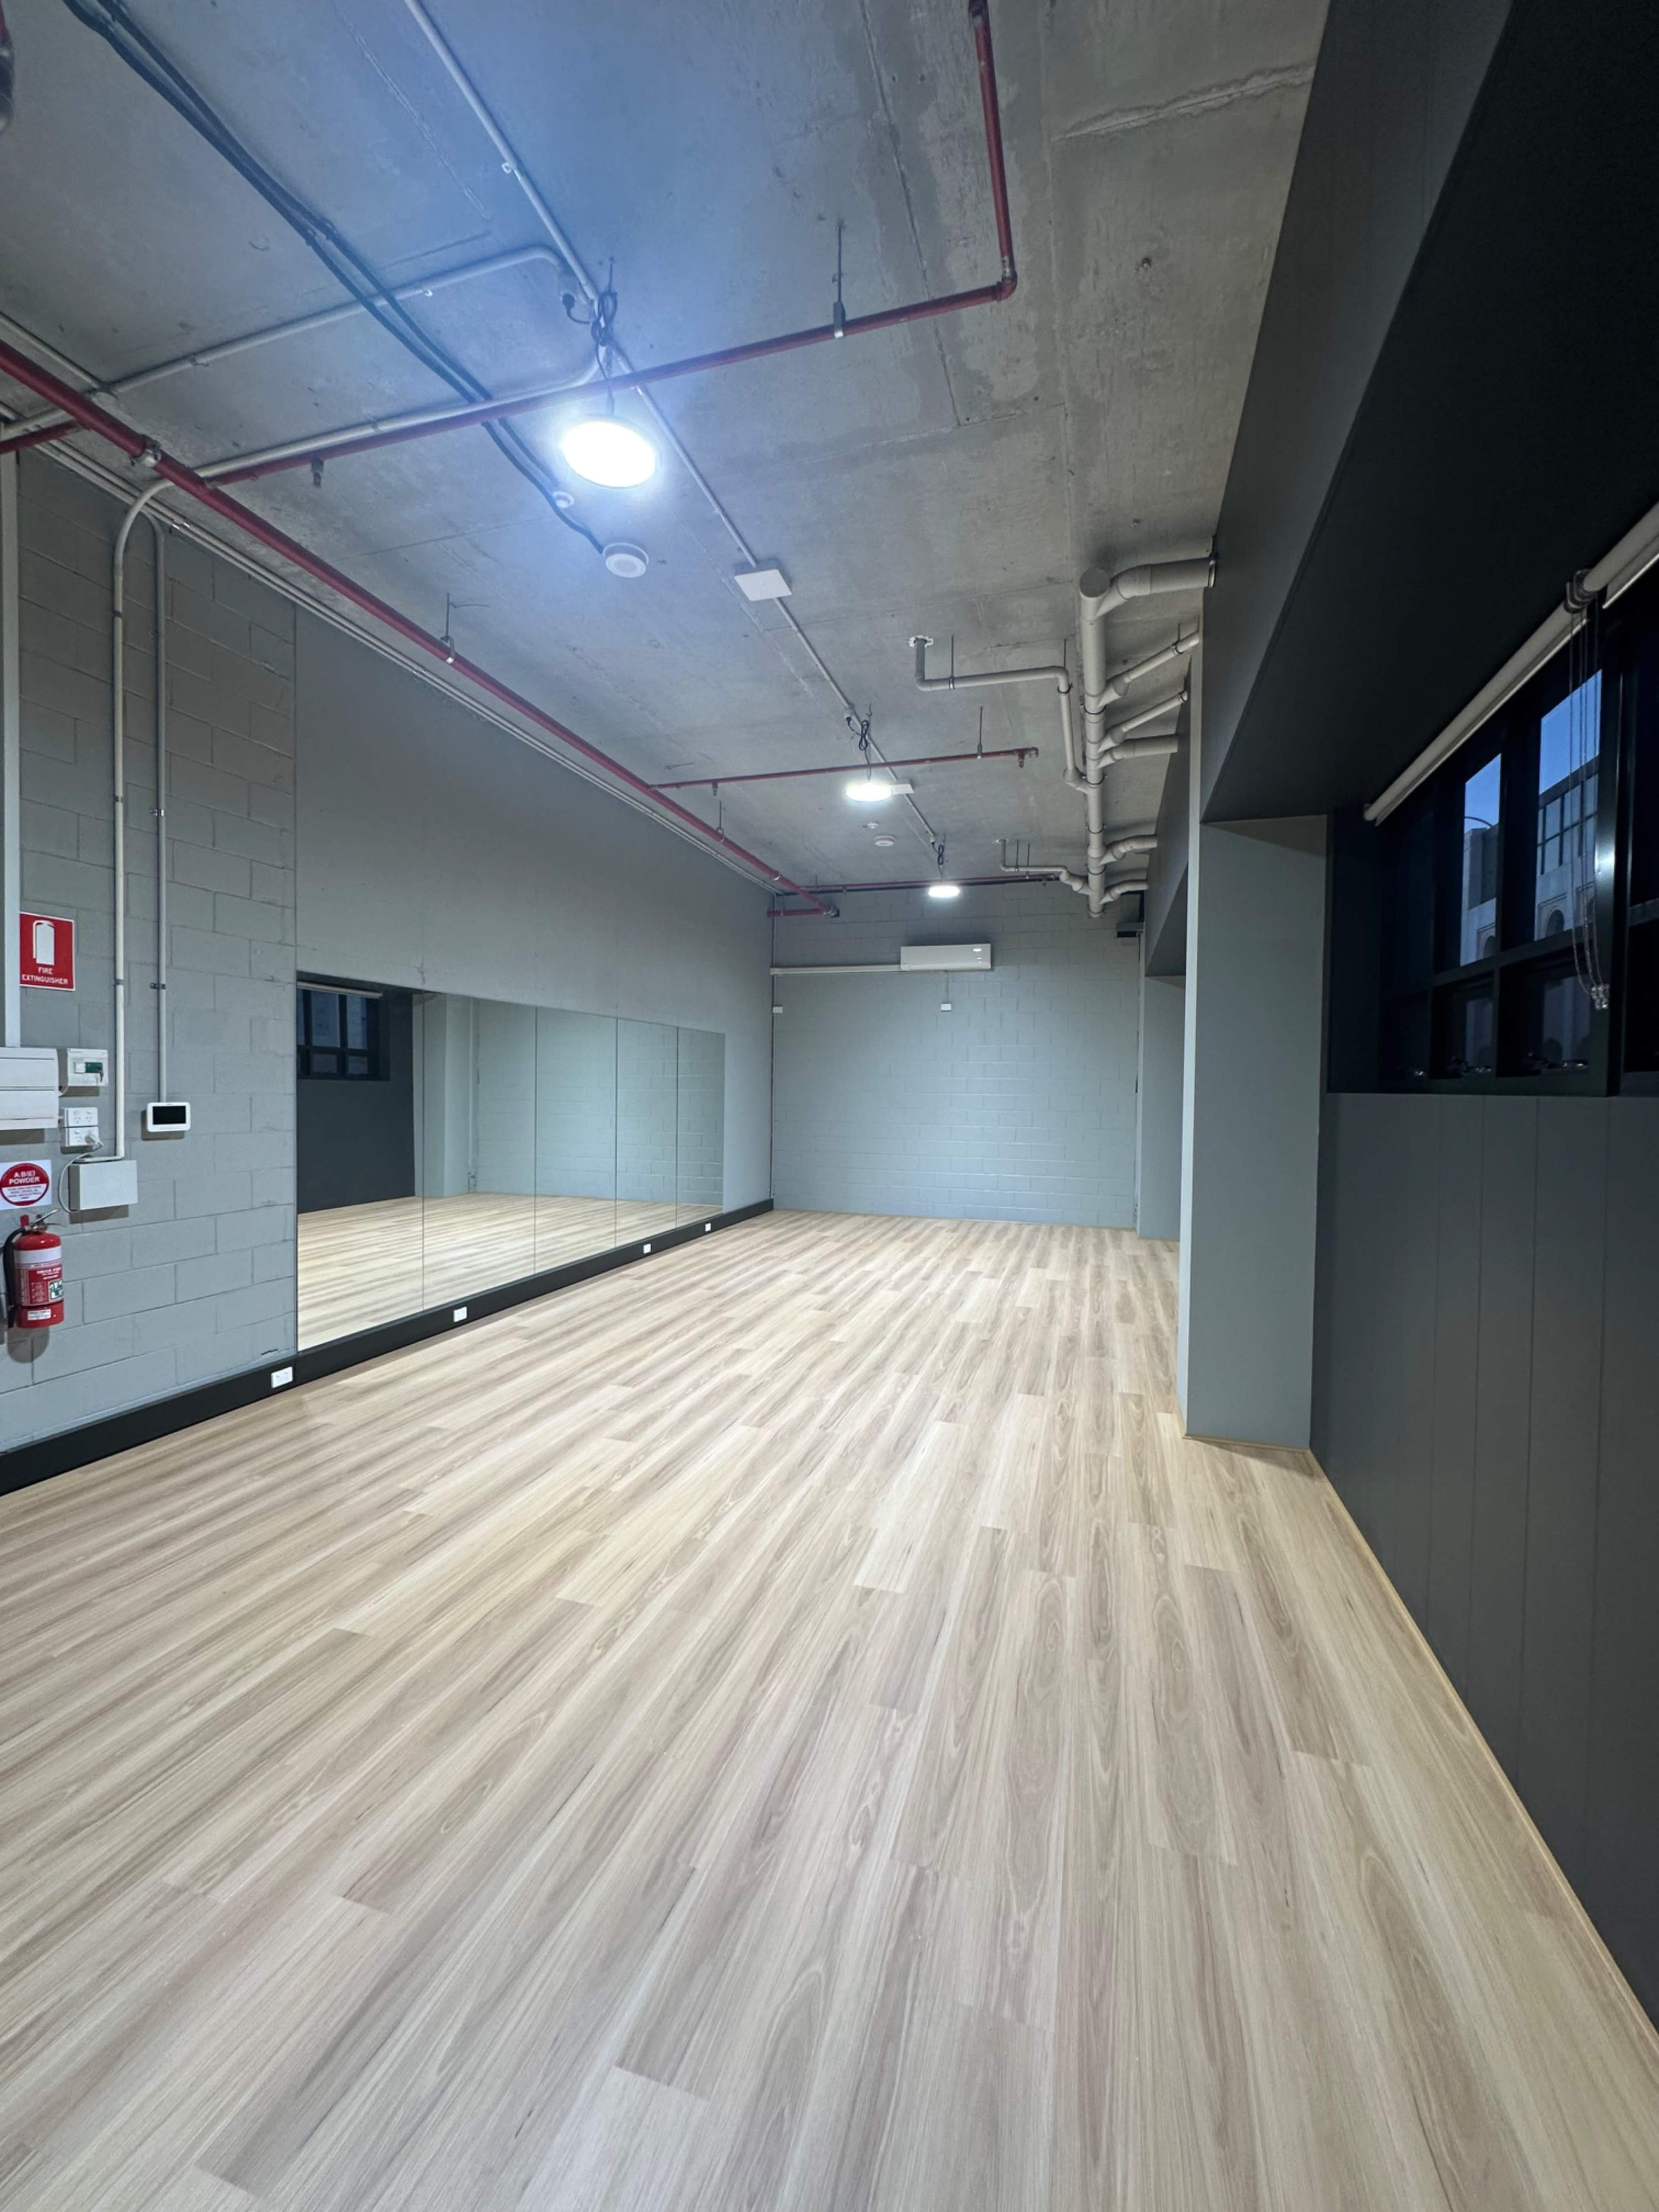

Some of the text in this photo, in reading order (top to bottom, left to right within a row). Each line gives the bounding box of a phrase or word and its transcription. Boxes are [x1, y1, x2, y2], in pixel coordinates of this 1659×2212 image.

[38, 966, 53, 975] FIRE
[22, 974, 69, 985] EXTINGUISHER
[9, 1176, 40, 1185] POWDER
